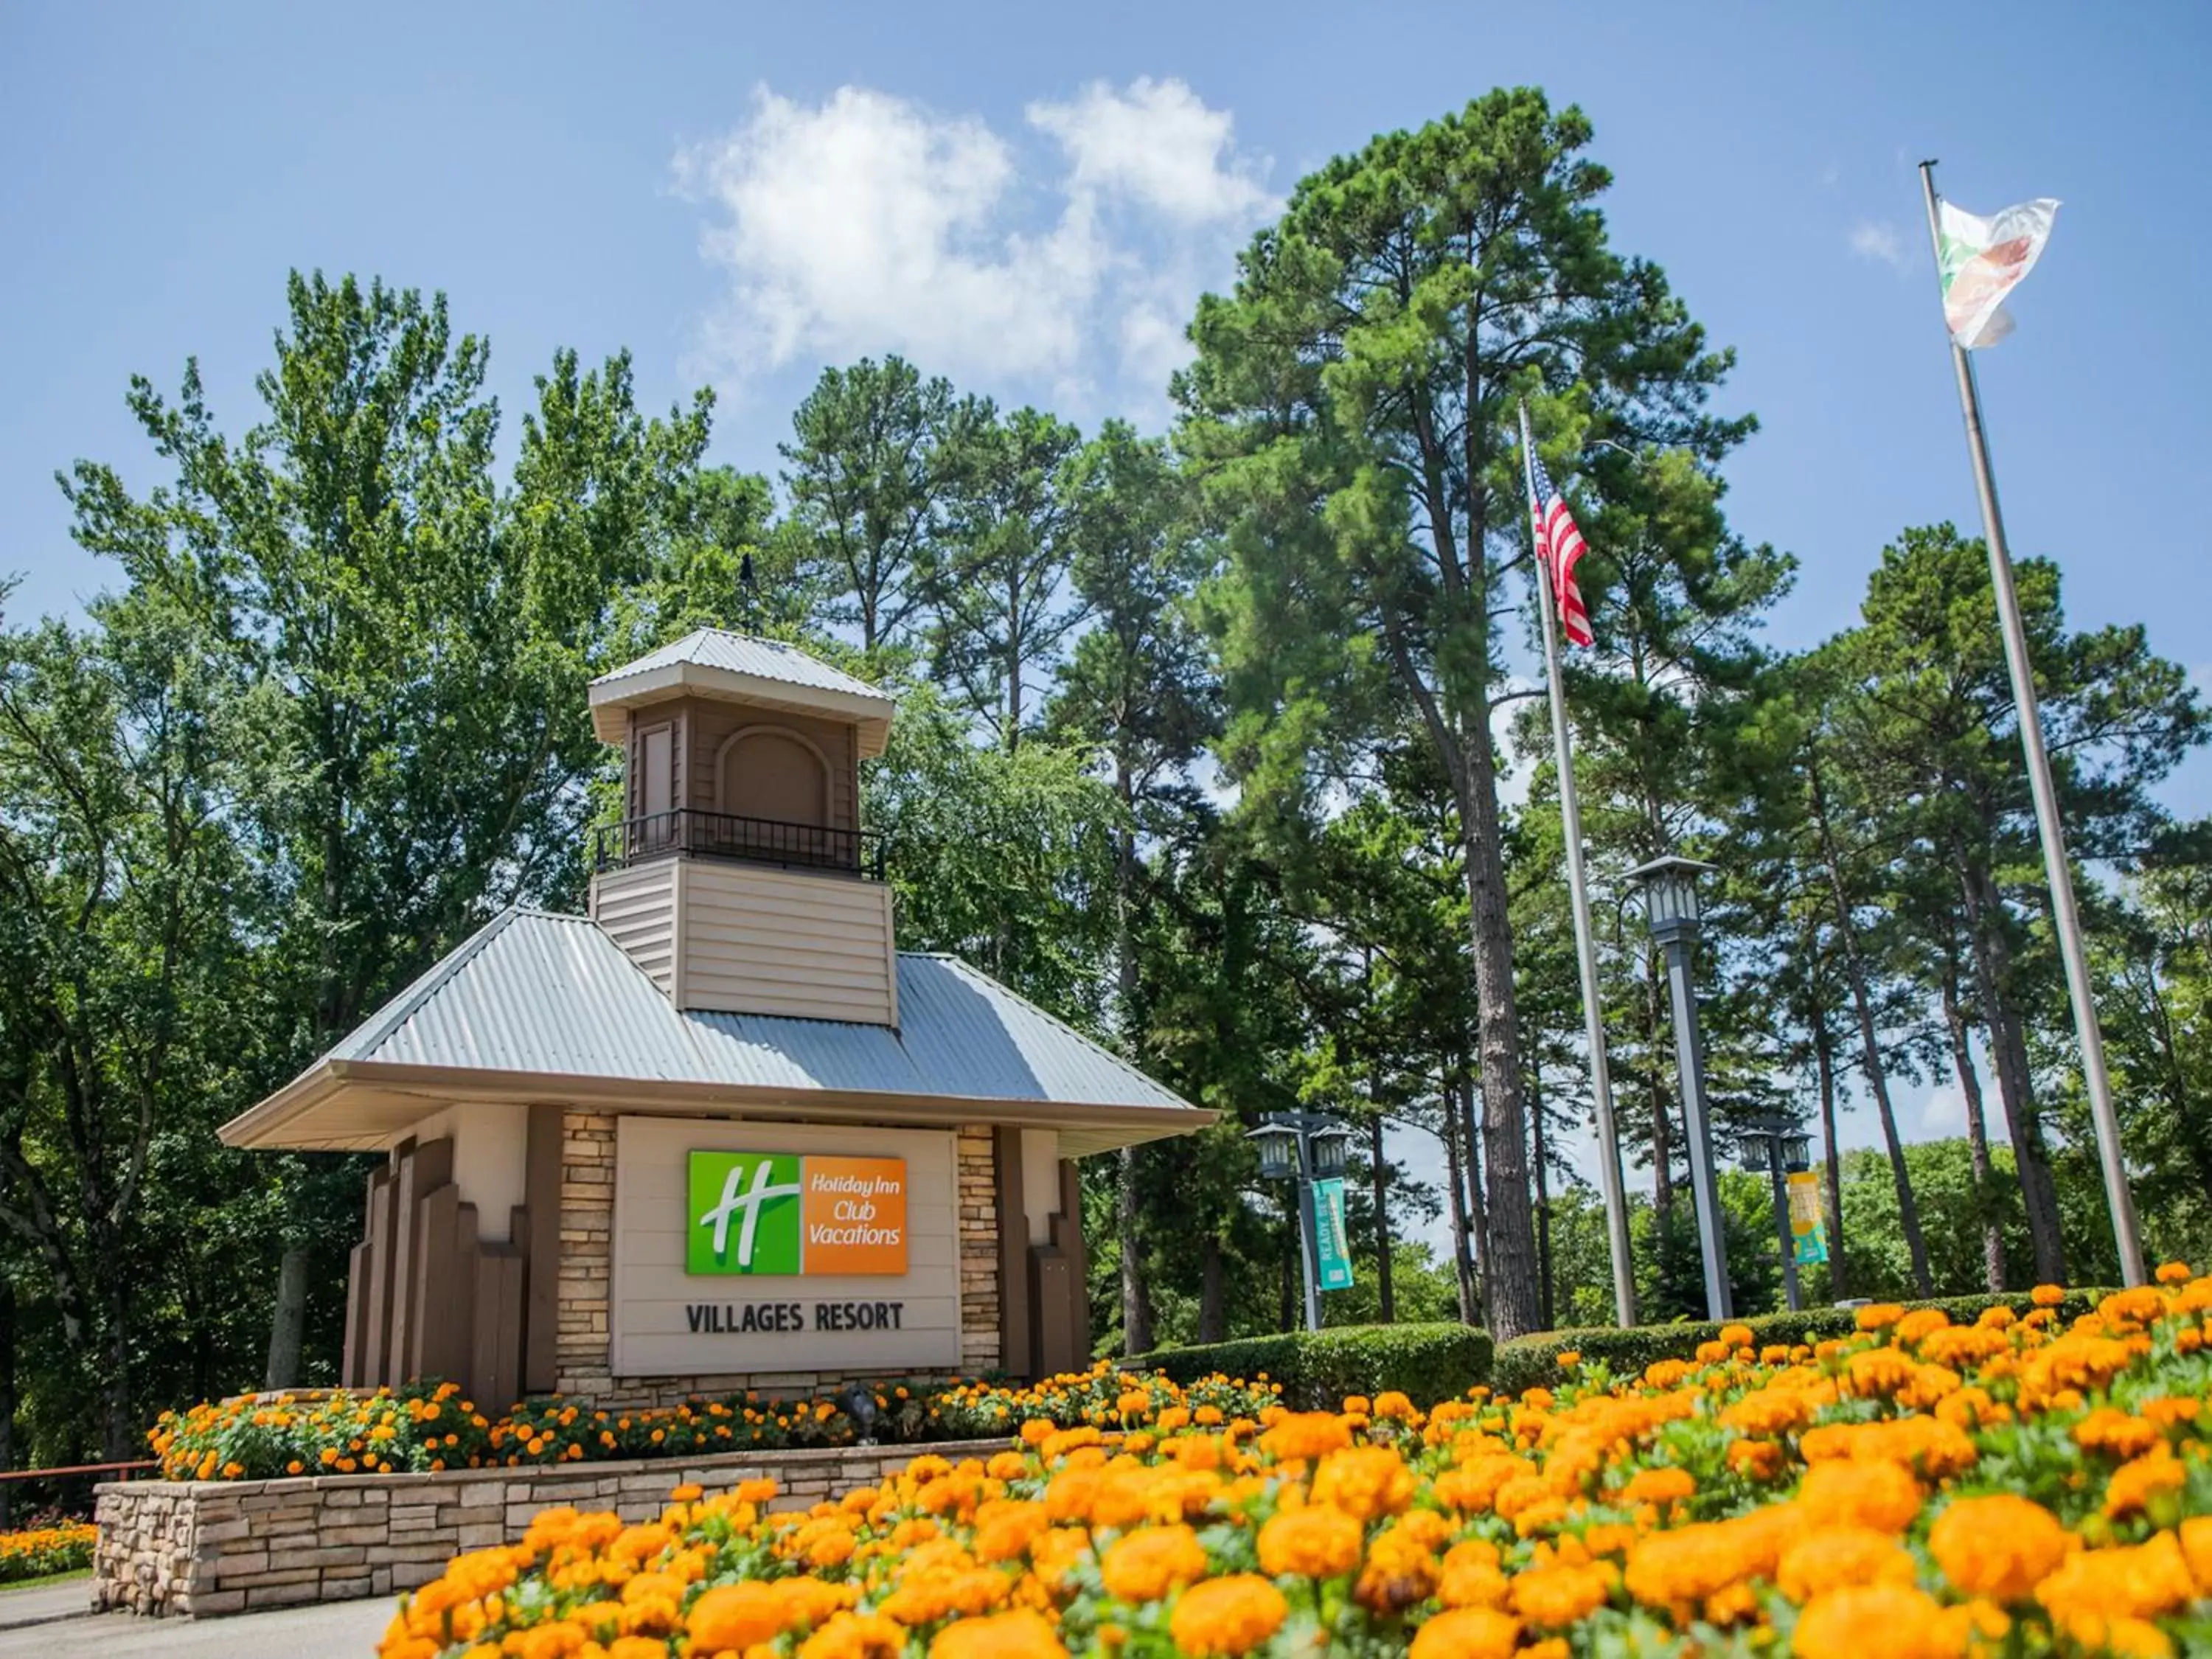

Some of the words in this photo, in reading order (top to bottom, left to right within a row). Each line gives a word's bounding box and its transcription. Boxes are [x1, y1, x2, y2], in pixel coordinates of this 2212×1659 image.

[811, 1173, 874, 1198] Holiday
[875, 1175, 900, 1194] Inn
[834, 1200, 876, 1221] Club
[810, 1222, 901, 1245] Vacations
[686, 1303, 804, 1333] VILLAGES
[815, 1302, 903, 1331] RESORT
